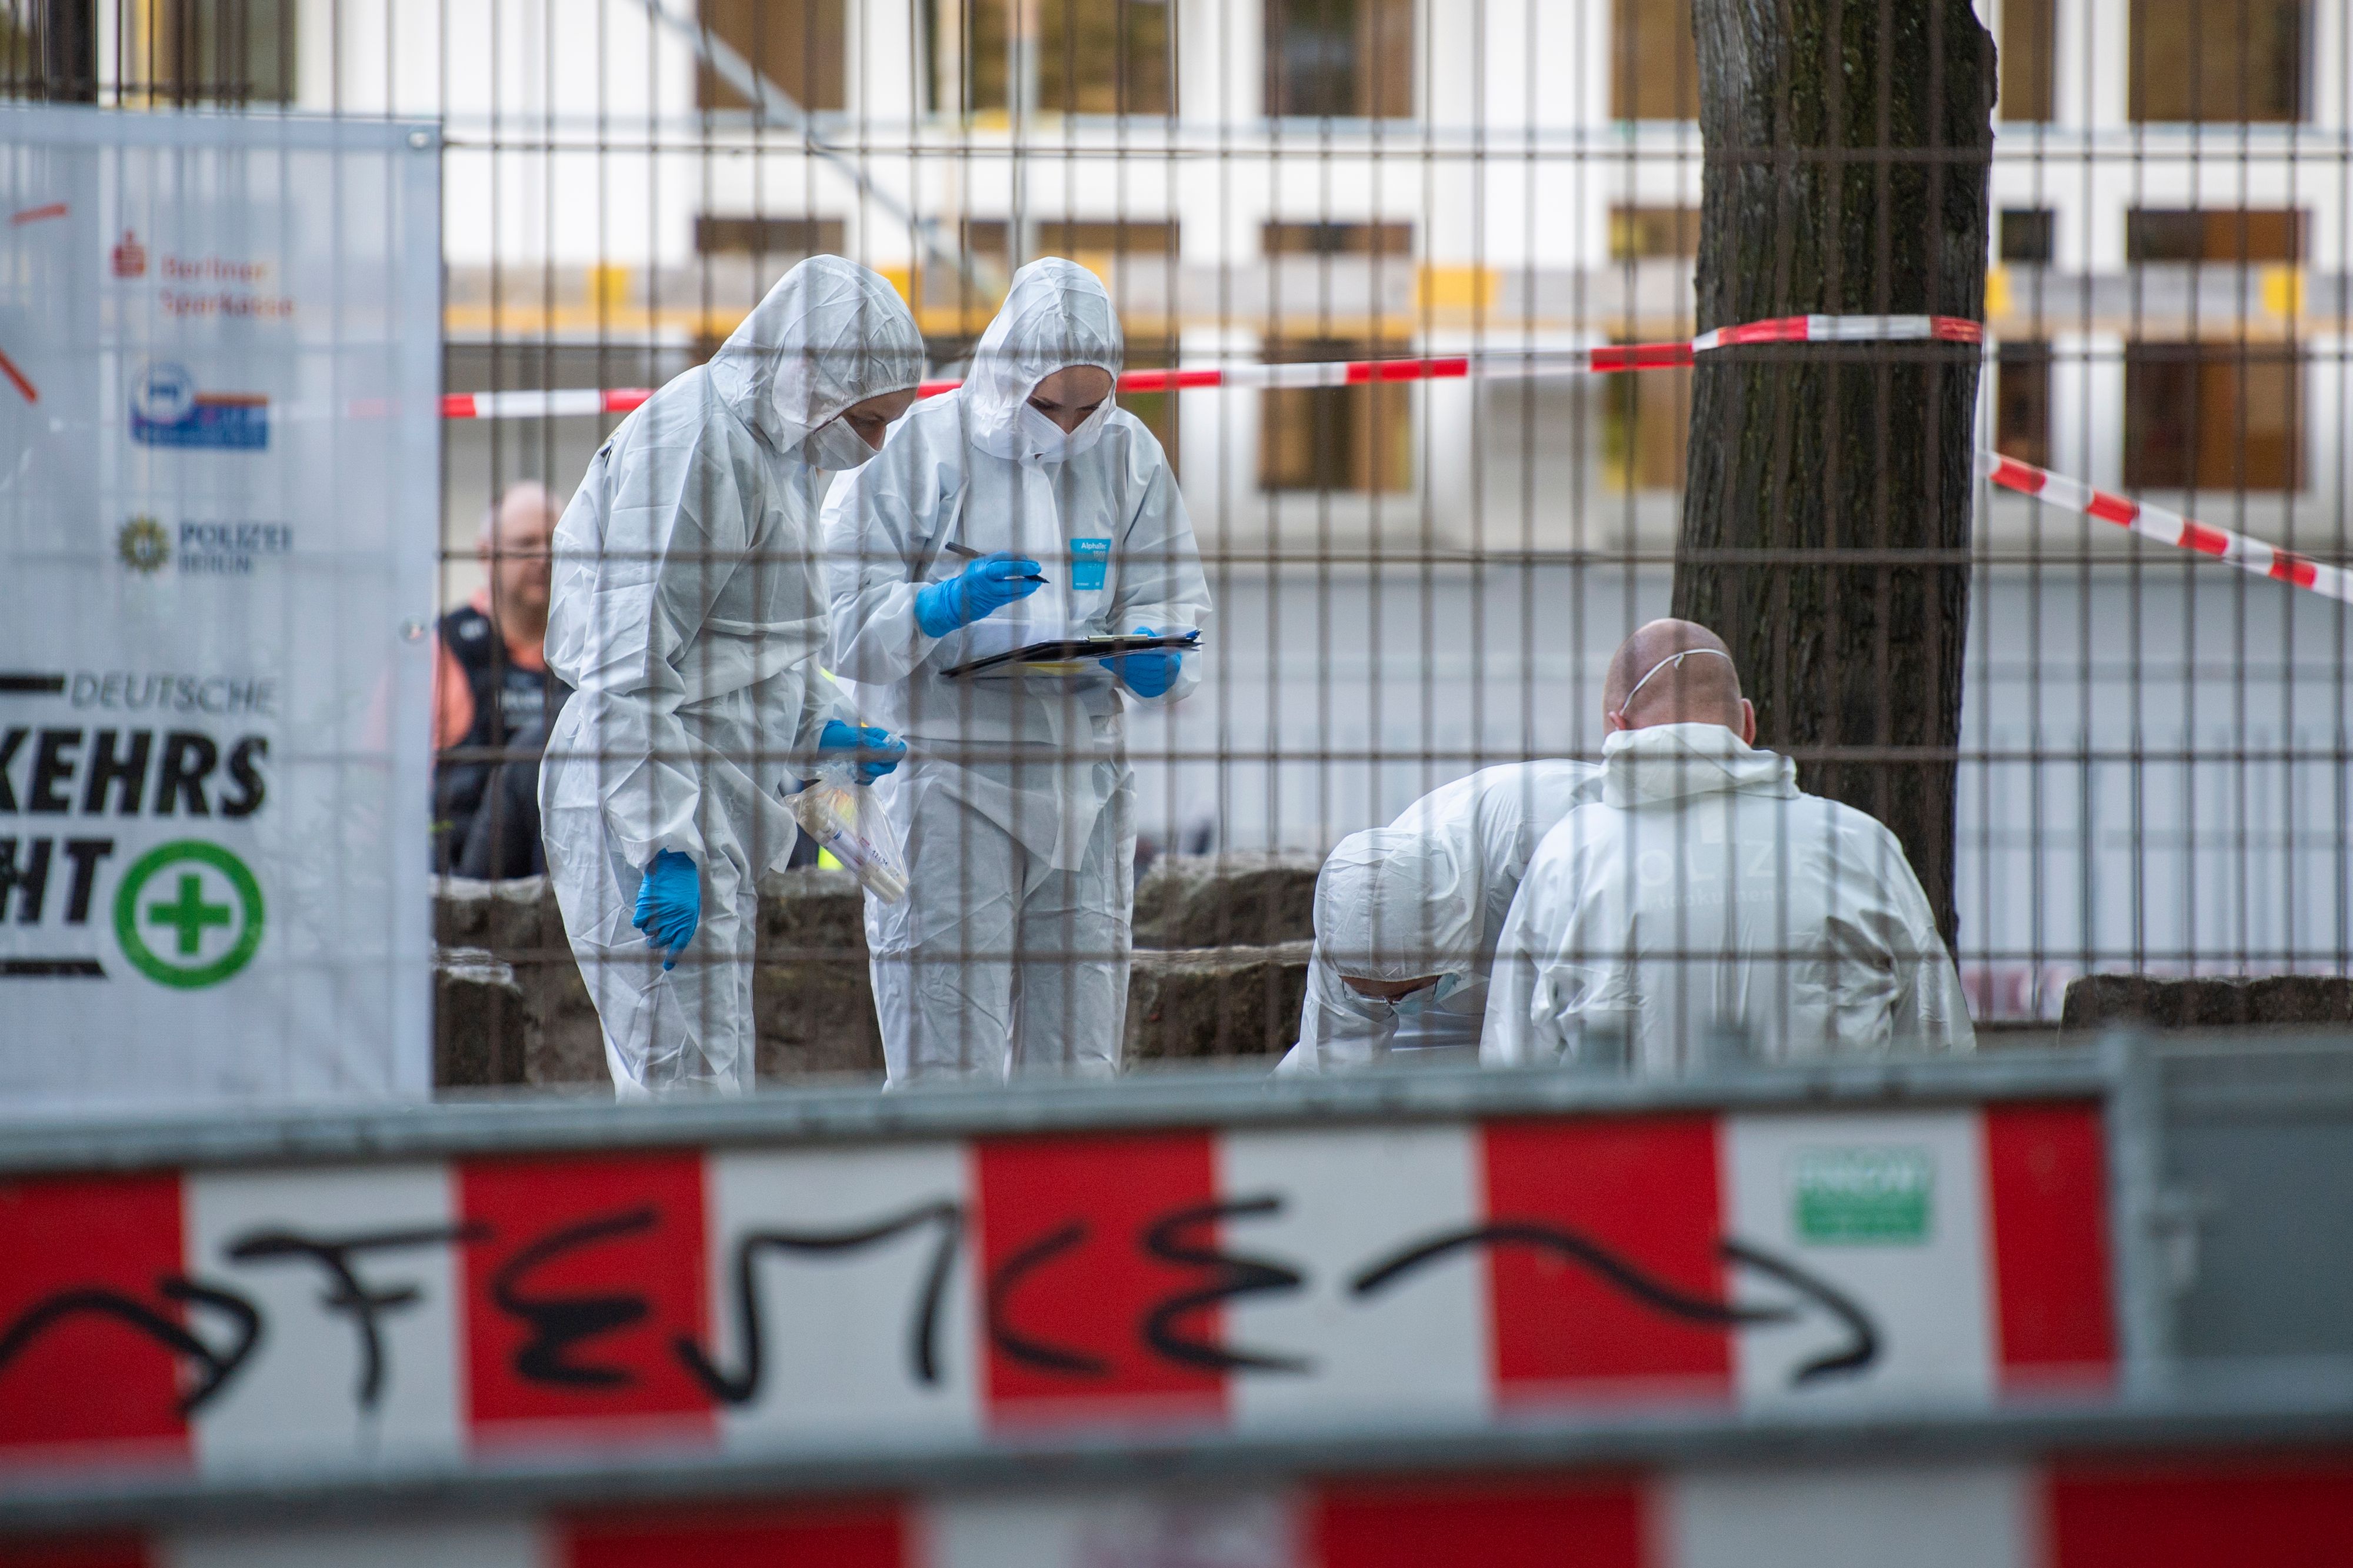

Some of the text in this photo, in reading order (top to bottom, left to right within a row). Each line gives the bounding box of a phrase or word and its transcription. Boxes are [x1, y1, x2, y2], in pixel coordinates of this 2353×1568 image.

[179, 521, 292, 553] POLIZEI
[179, 555, 252, 575] BERLIN
[71, 673, 276, 714] DEUTSCHE
